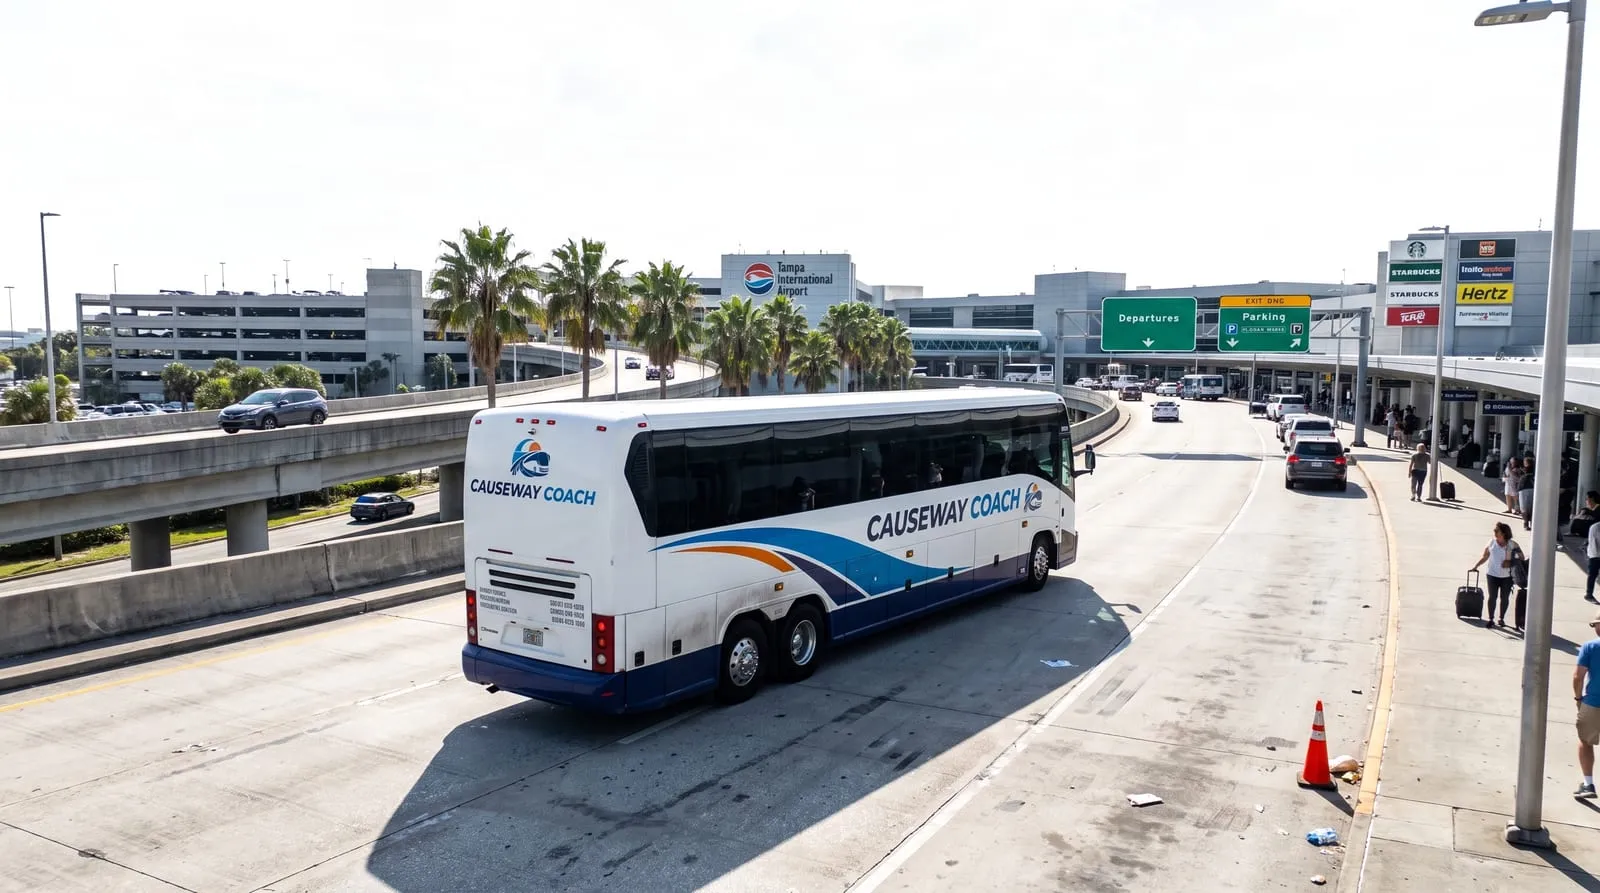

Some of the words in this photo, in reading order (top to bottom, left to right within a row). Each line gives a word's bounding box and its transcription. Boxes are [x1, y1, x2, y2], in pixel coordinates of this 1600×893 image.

[777, 262, 805, 275] Tampa
[777, 273, 833, 285] International
[777, 285, 808, 298] Airport
[1462, 287, 1508, 300] Hertz
[1118, 313, 1180, 323] Departures
[1242, 312, 1286, 324] Parking
[1228, 325, 1236, 333] P
[470, 479, 542, 499] CAUSEWAY
[543, 486, 597, 505] COACH
[866, 498, 969, 542] CAUSEWAY
[970, 487, 1021, 519] COACH
